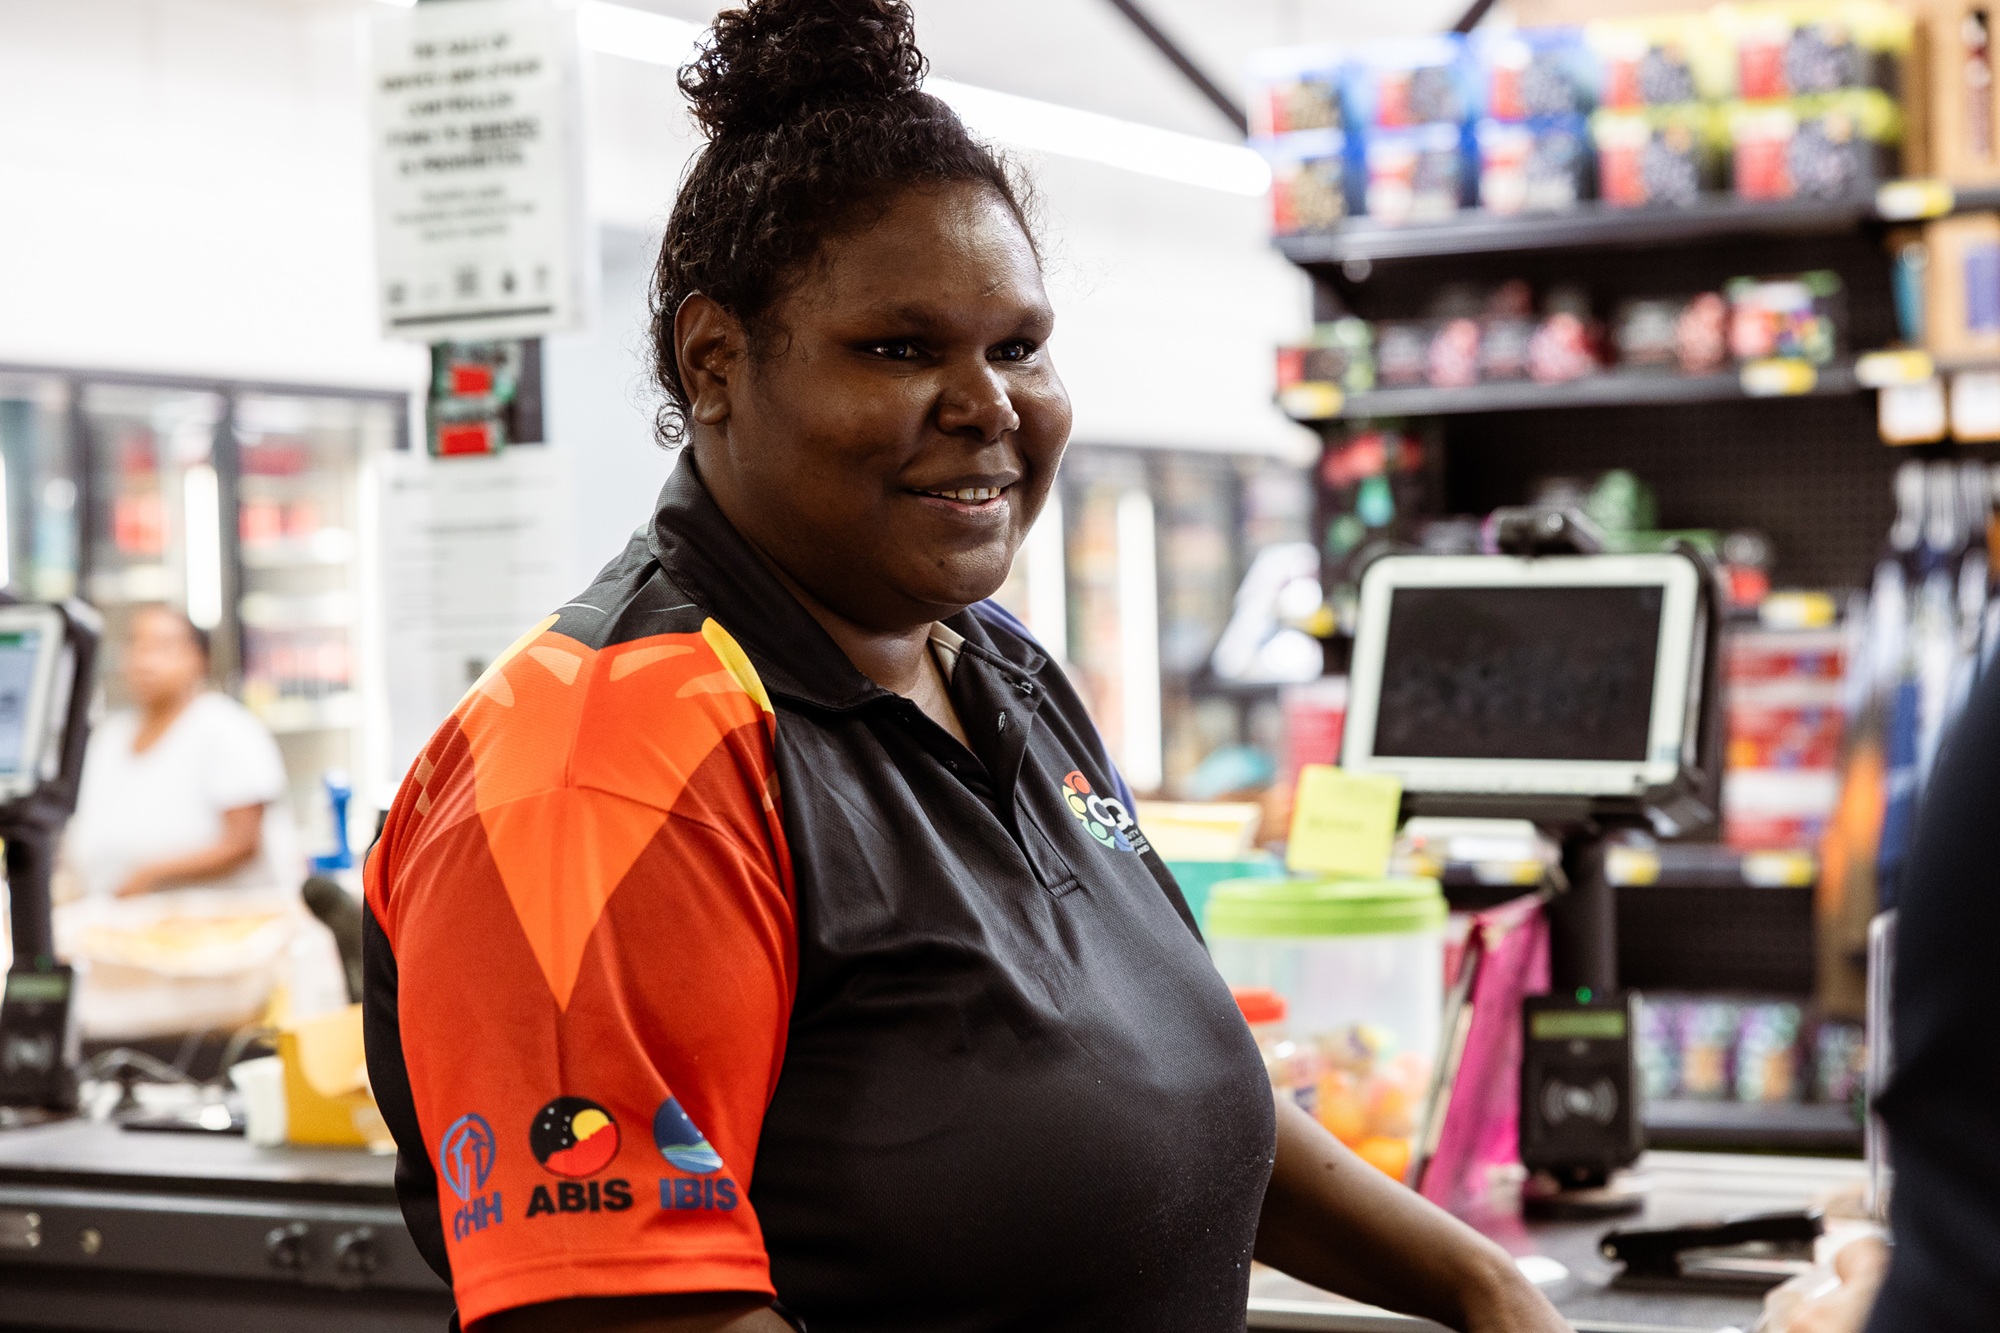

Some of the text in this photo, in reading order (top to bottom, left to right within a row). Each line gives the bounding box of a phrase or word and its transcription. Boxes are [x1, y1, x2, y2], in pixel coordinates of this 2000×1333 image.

[526, 1178, 634, 1218] ABIS
[659, 1178, 738, 1211] IBIS
[454, 1191, 503, 1241] CHH
